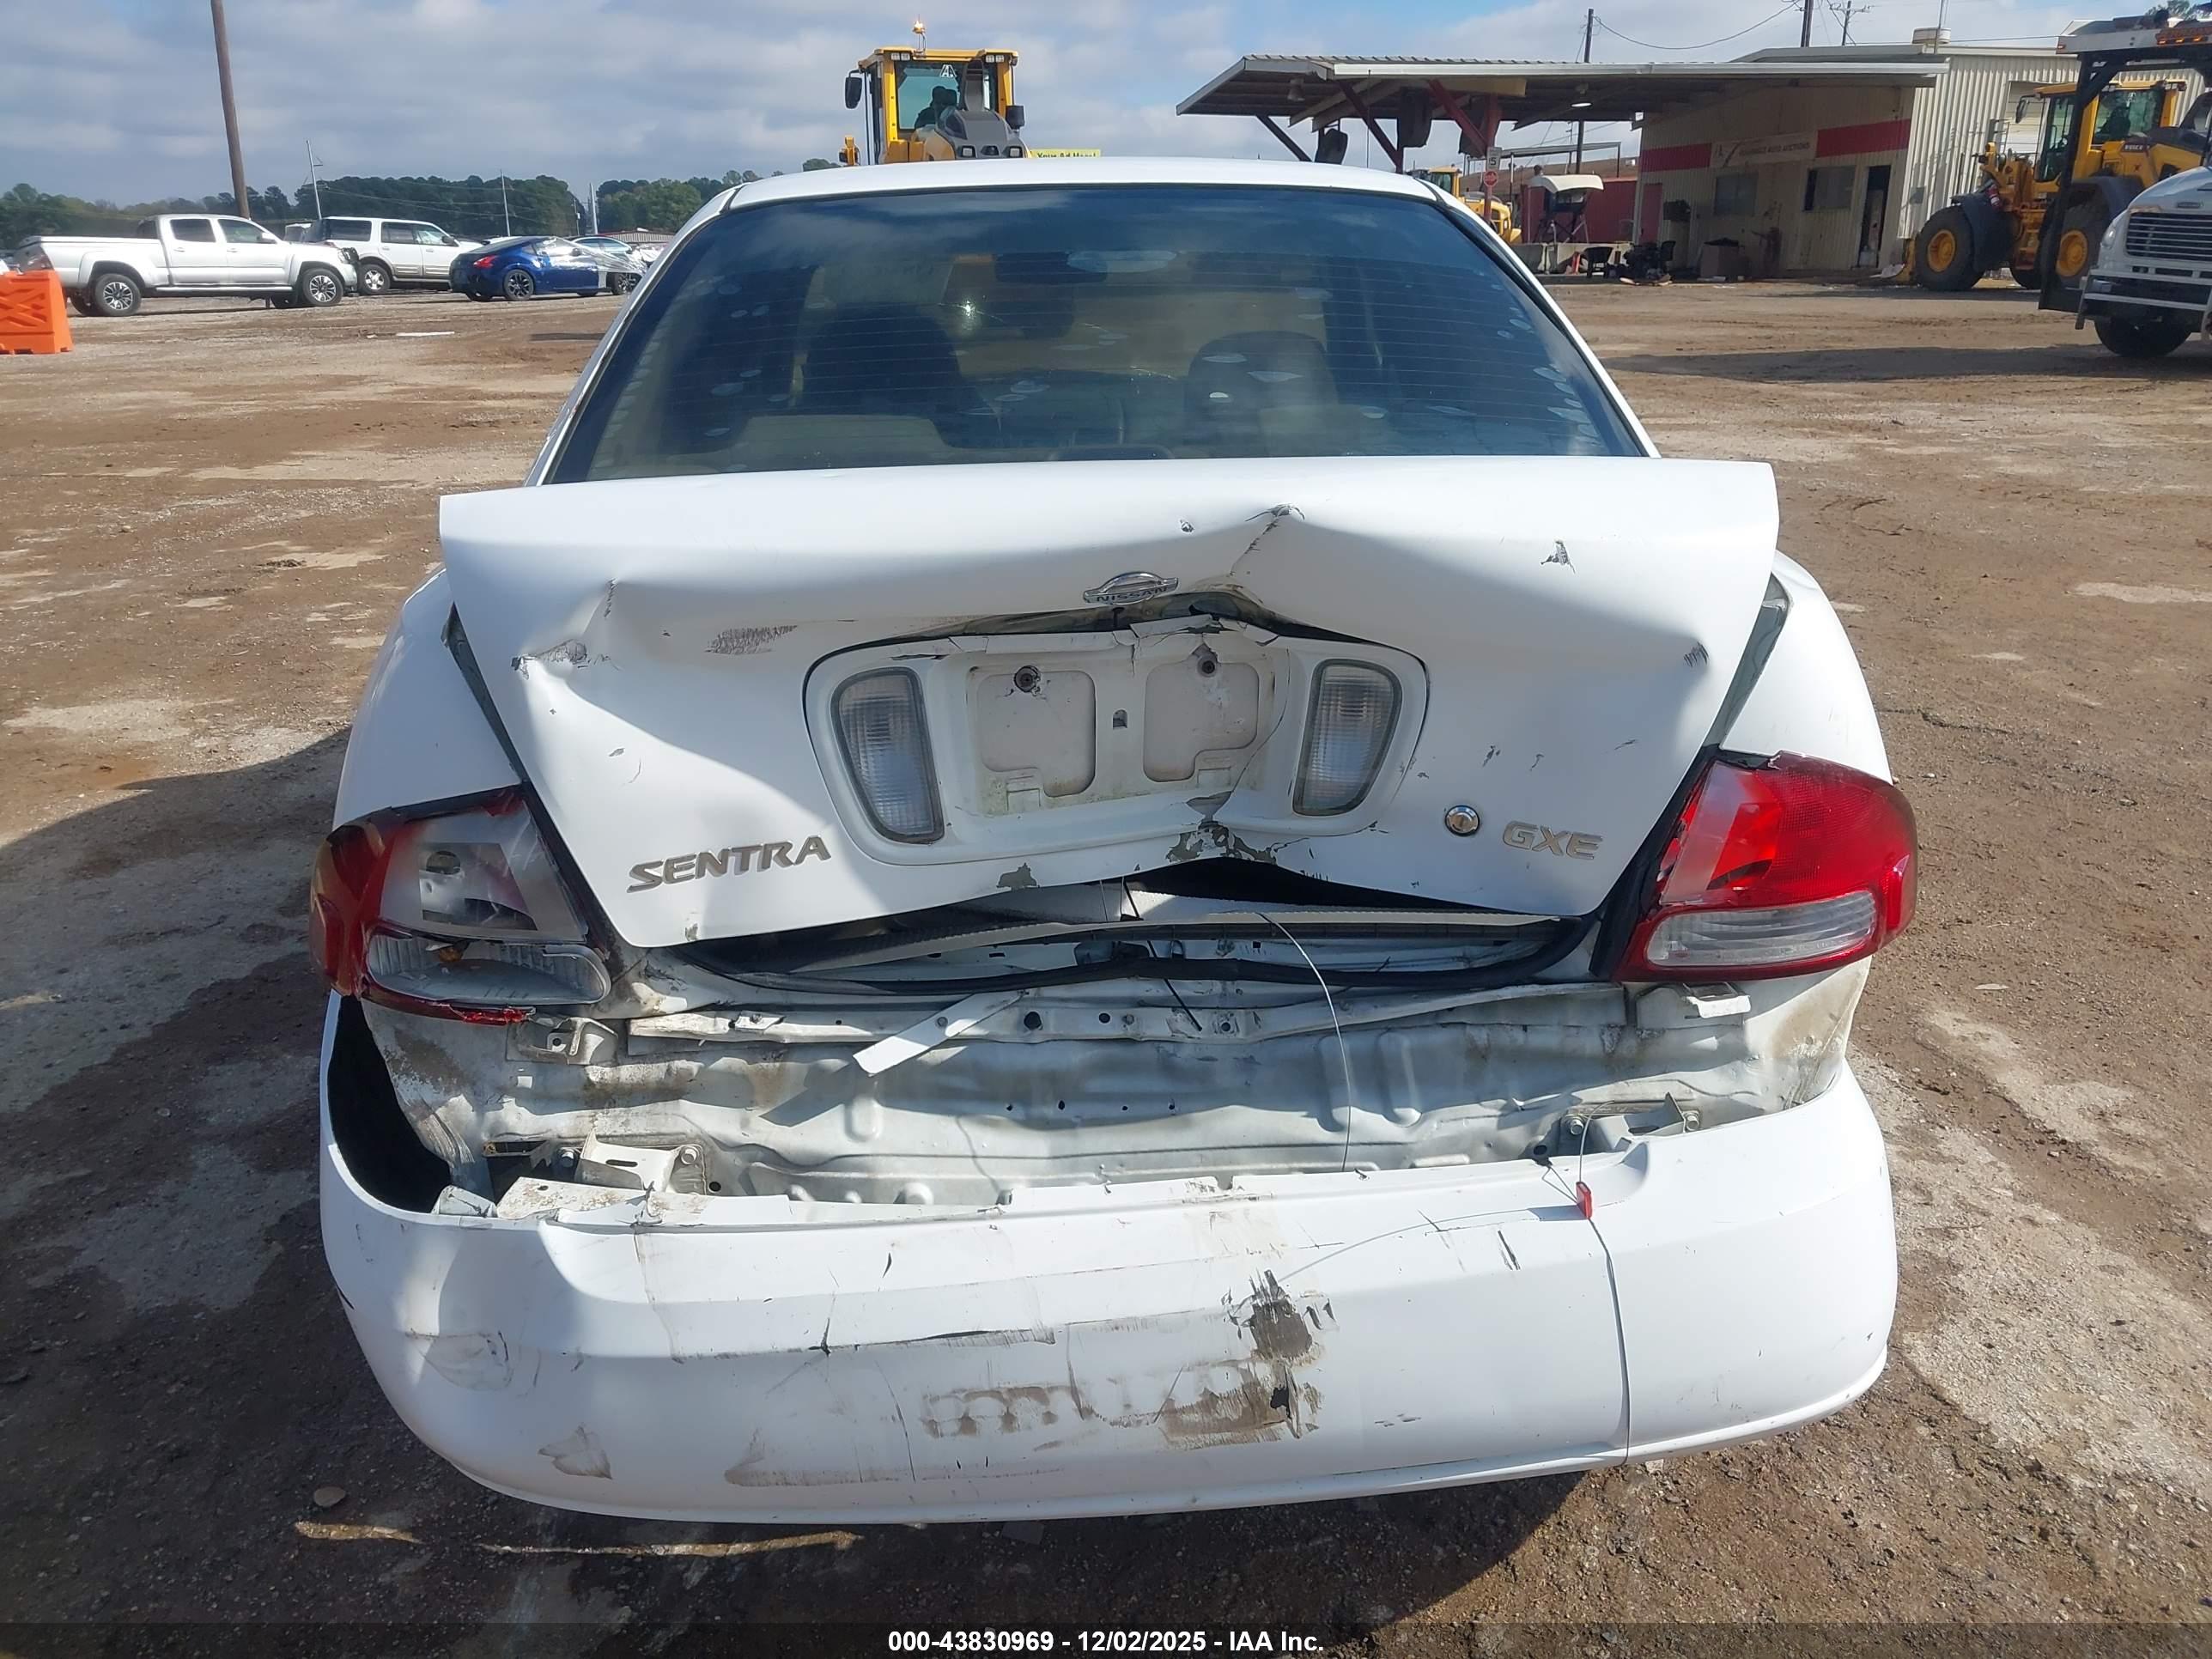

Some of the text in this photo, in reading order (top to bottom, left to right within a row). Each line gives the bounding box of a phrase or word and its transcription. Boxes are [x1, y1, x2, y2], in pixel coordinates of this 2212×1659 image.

[1097, 586, 1168, 602] NISSAN
[1503, 820, 1603, 860] GXE
[626, 835, 831, 893] SENTRA
